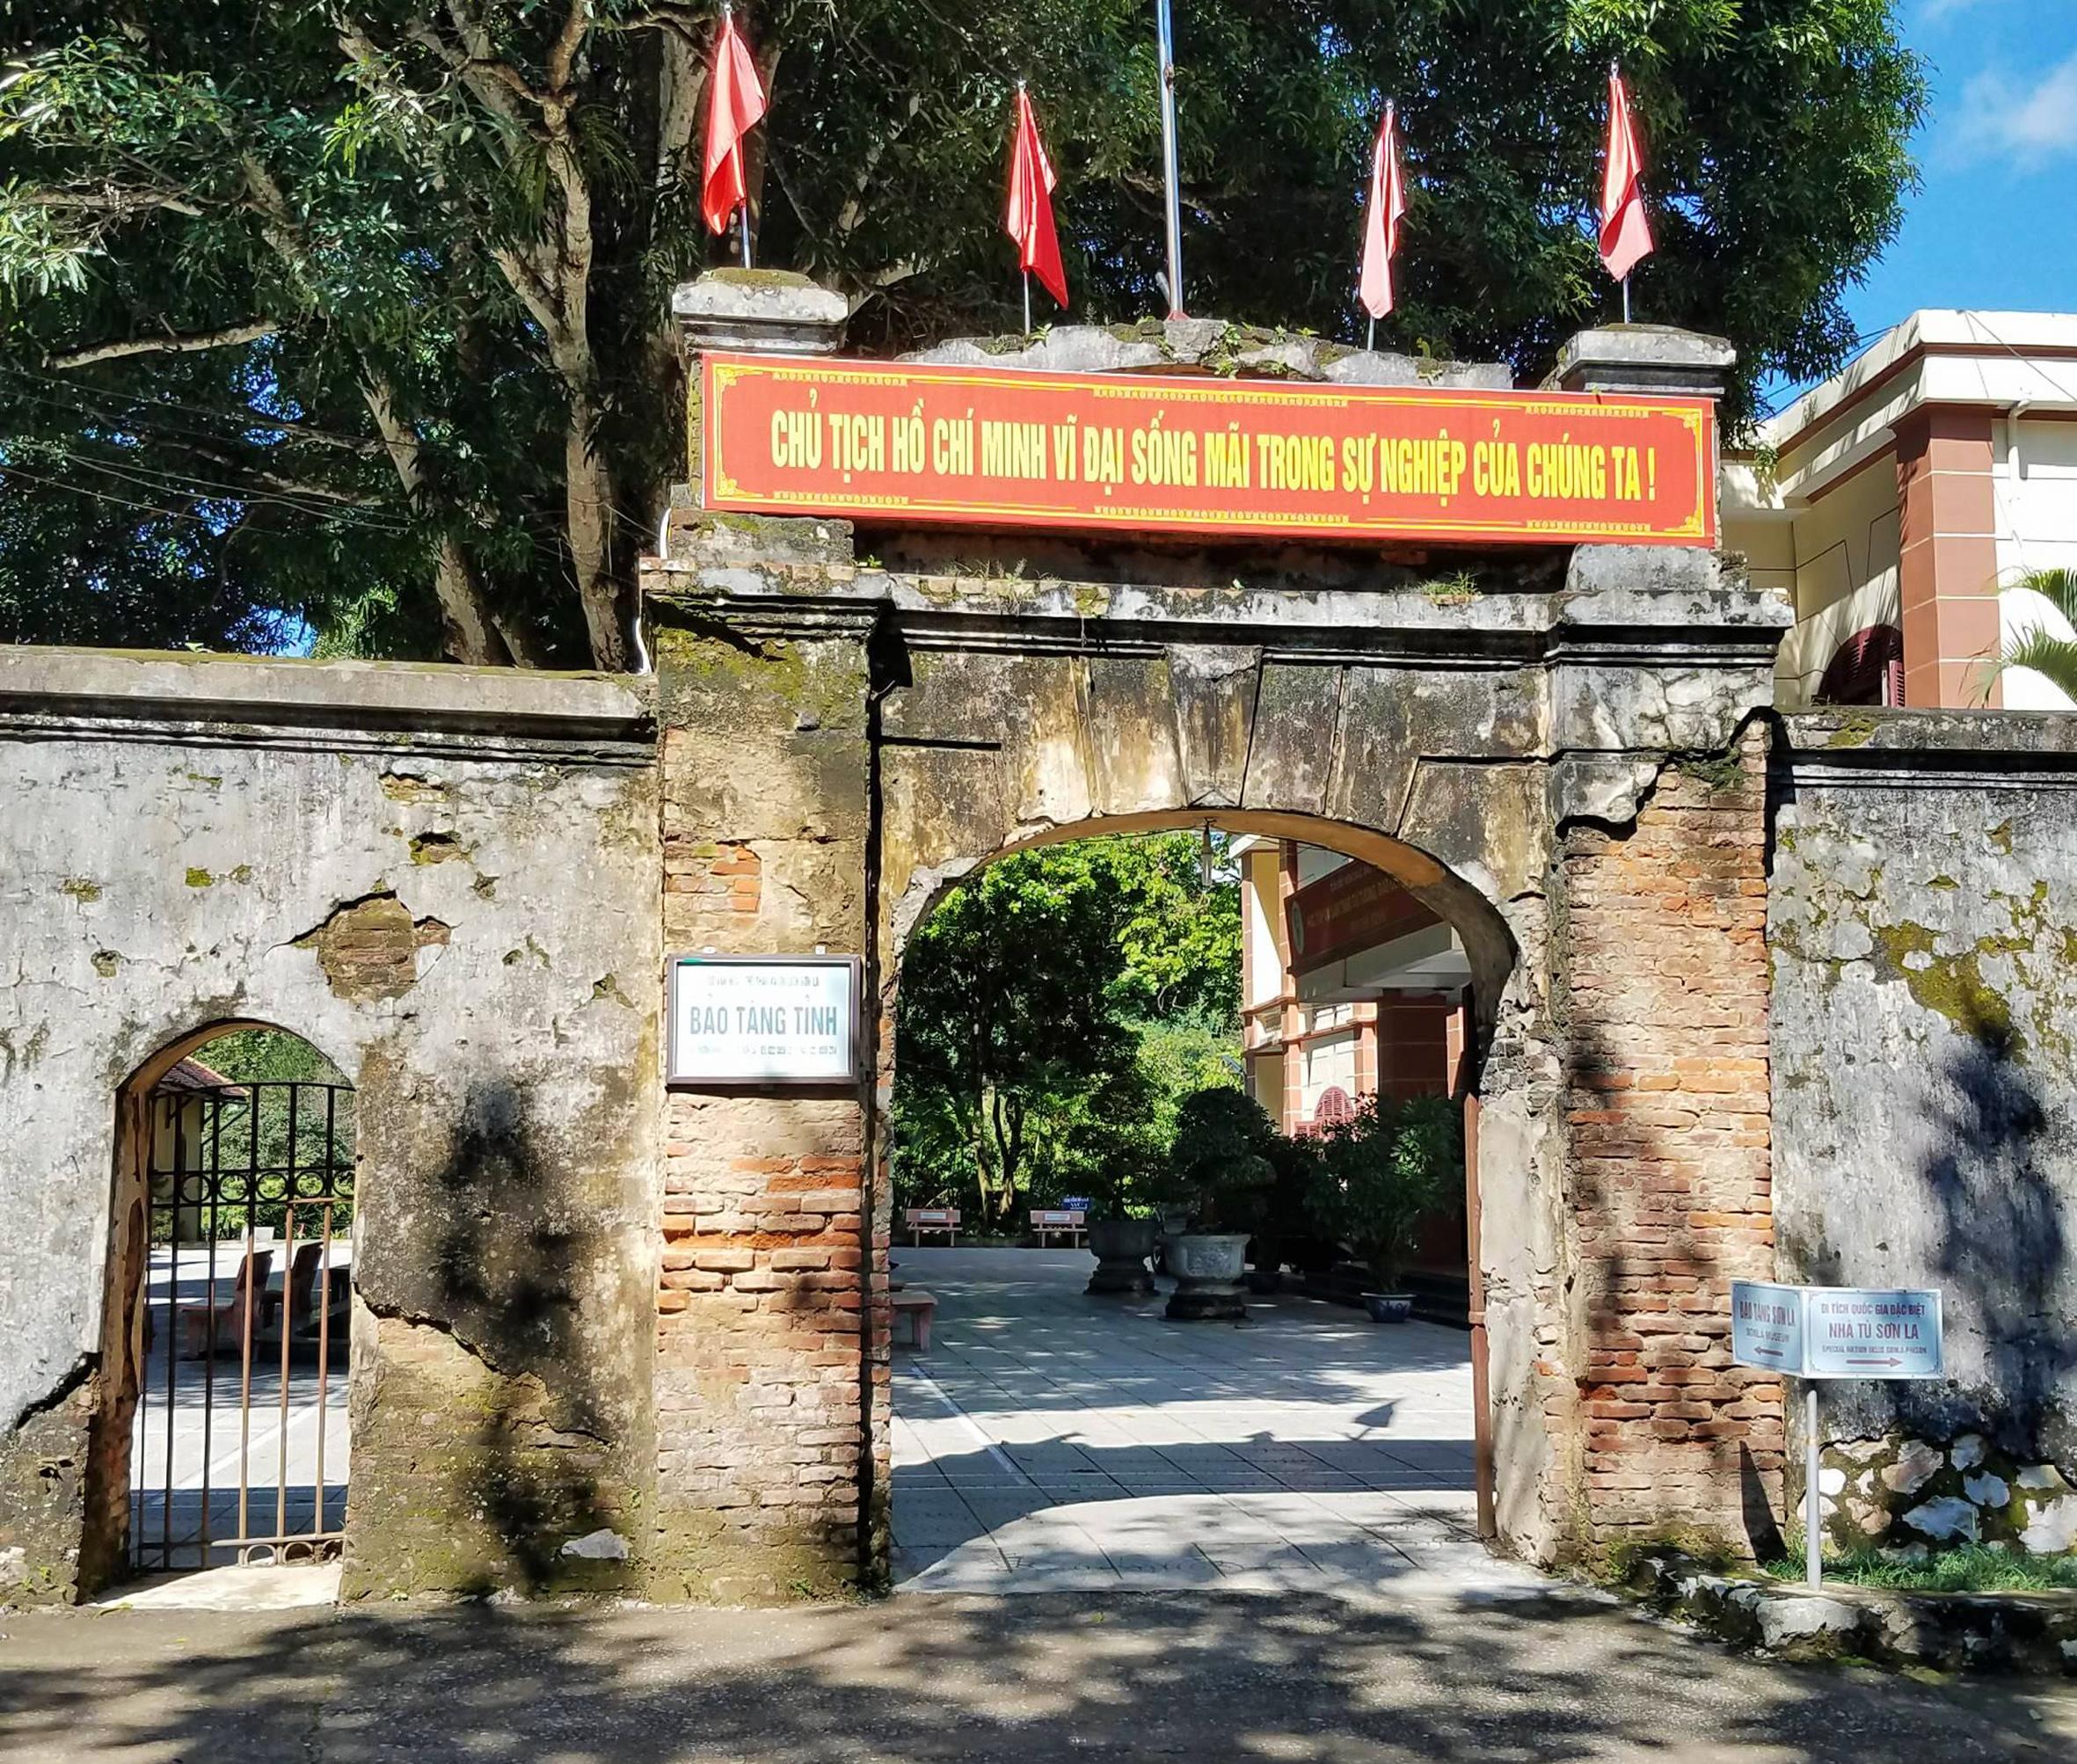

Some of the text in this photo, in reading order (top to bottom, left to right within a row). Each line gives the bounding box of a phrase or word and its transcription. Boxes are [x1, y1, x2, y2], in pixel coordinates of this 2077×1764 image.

[771, 388, 821, 469] CHỦ
[829, 413, 884, 483] TỊCH
[893, 398, 927, 473] HỒ
[933, 408, 973, 475] CHÍ
[981, 421, 1046, 479] MINH
[1053, 414, 1077, 480] VĨ
[1083, 426, 1123, 495] ĐẠI
[1132, 410, 1197, 486] SỐNG
[1205, 422, 1250, 487] MÃI
[1257, 434, 1335, 491] TRONG
[1343, 433, 1376, 504] SỰ
[1381, 429, 1466, 507] NGHIỆP
[1474, 419, 1520, 496] CỦA
[1527, 434, 1605, 499] CHÚNG
[689, 993, 838, 1036] BẢO TÀNG TỈNH
[1829, 1319, 1854, 1339] NHÀ
[1876, 1322, 1901, 1340] SƠN
[1904, 1323, 1920, 1340] LA
